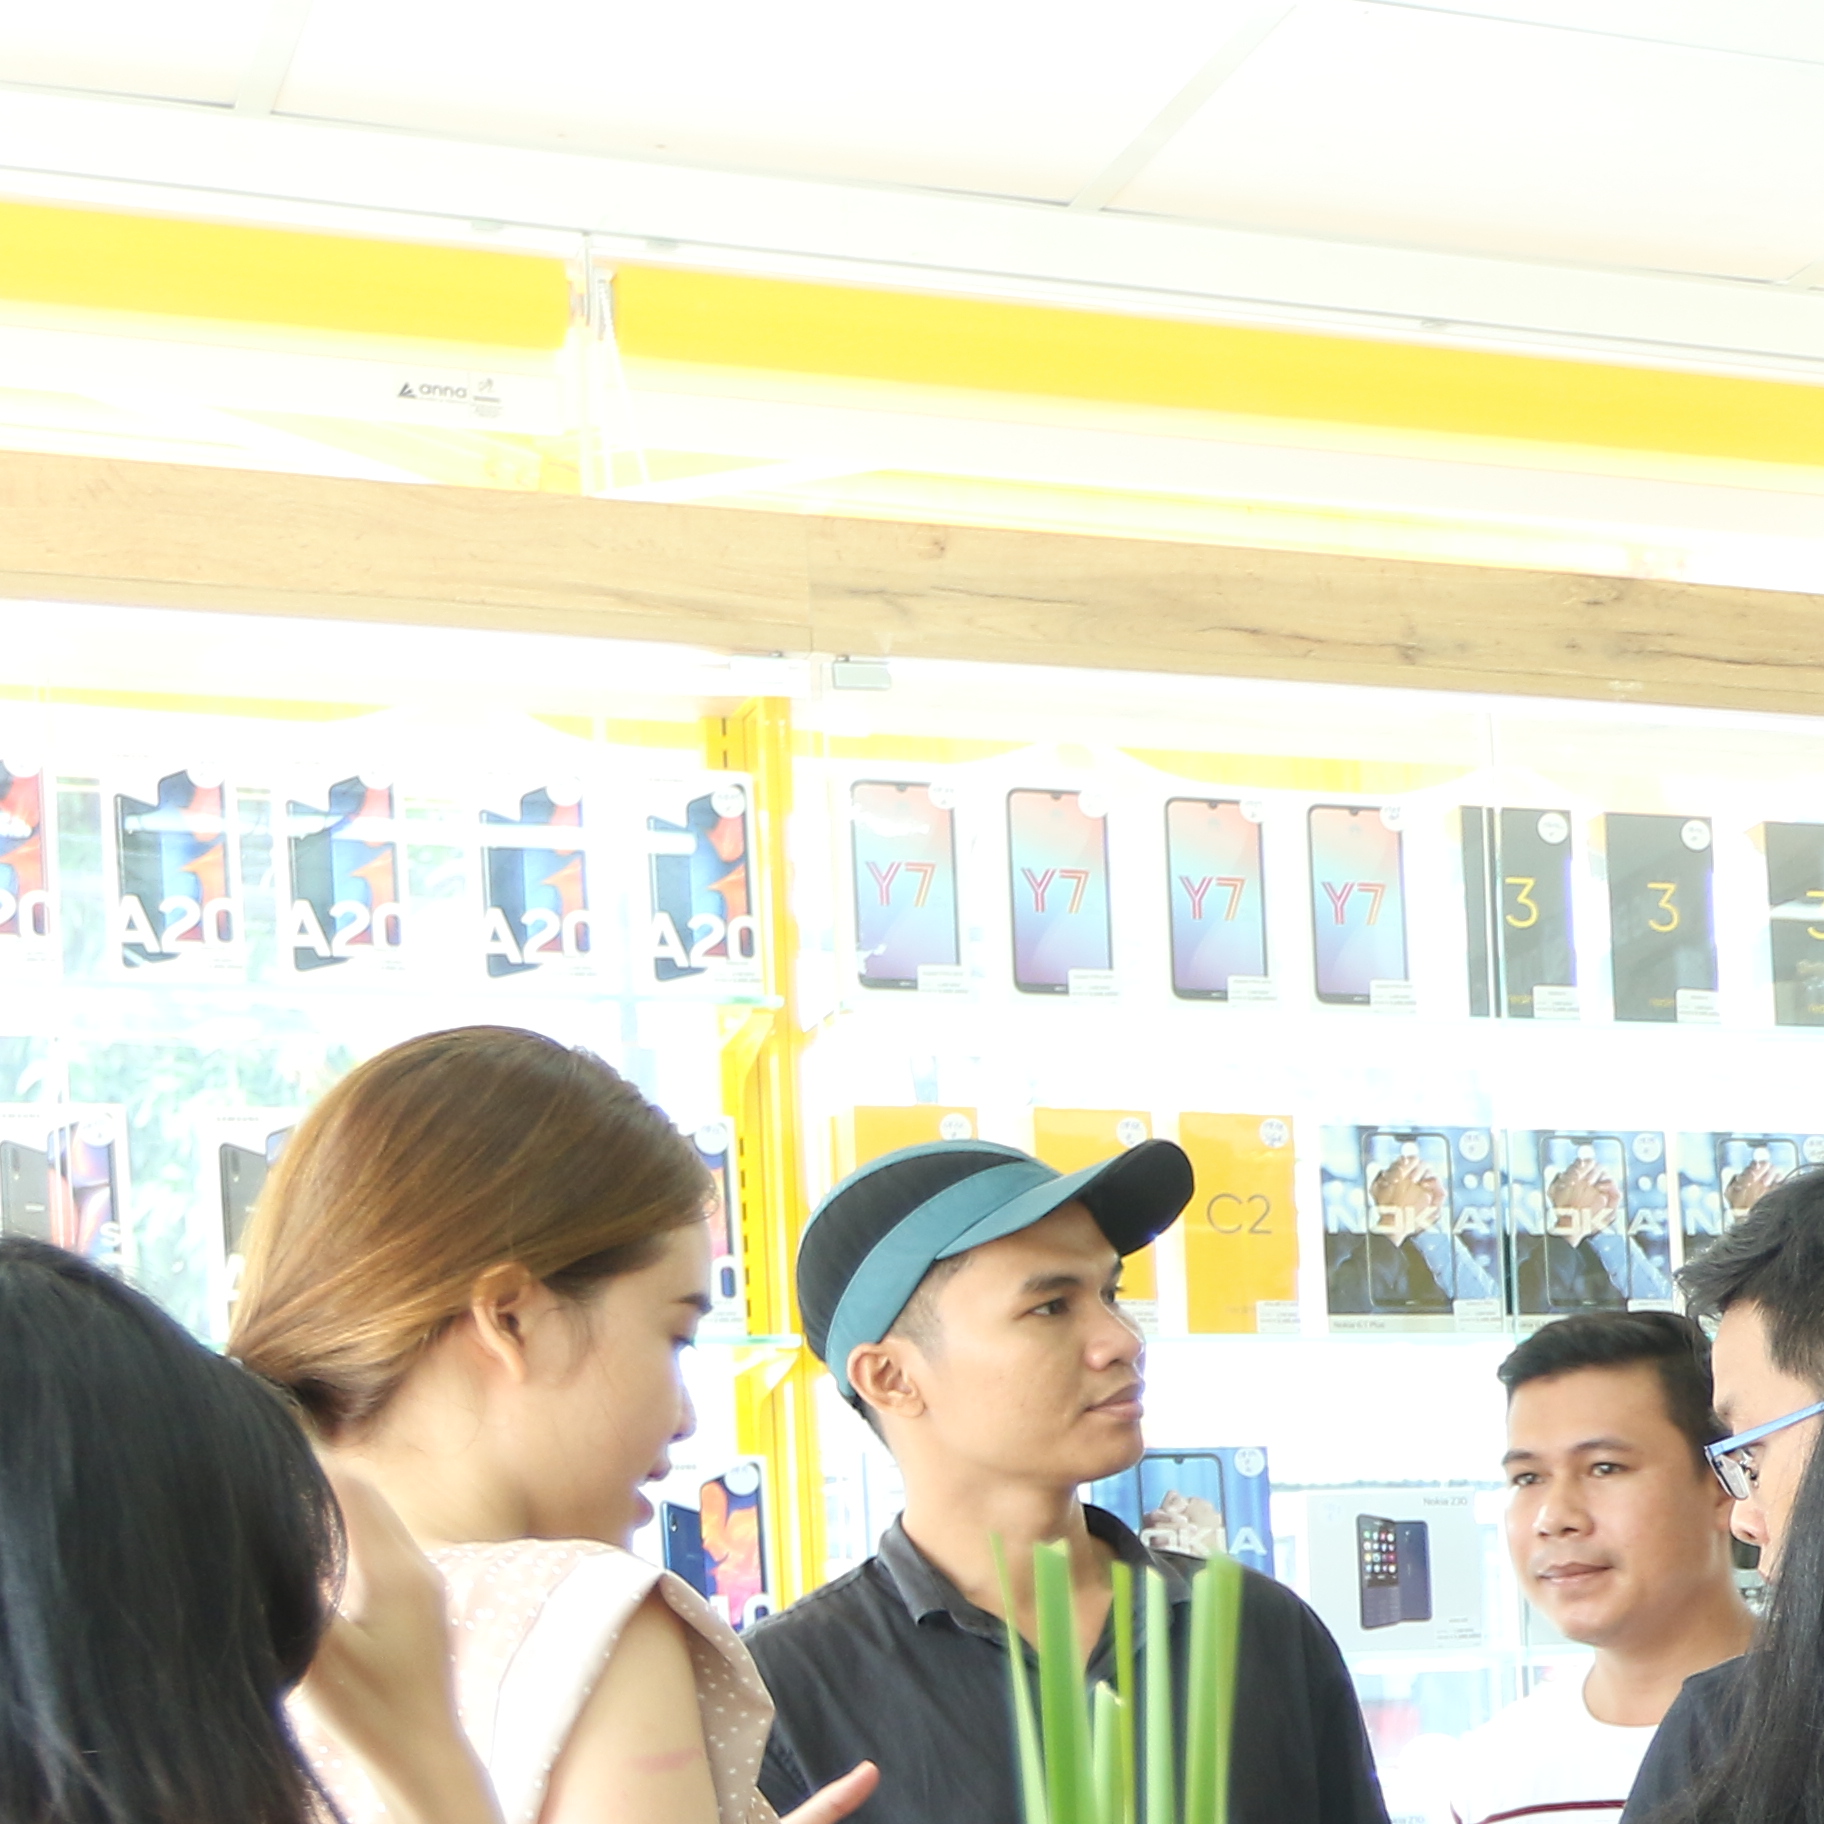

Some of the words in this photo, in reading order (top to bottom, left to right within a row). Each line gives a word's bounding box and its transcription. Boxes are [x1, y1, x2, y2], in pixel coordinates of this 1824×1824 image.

[865, 861, 936, 907] Y7
[1022, 868, 1089, 913] Y7
[1179, 876, 1246, 921] Y7
[1322, 881, 1386, 925] Y7
[1505, 877, 1539, 928] 3
[114, 895, 246, 955] A20
[285, 899, 412, 957] A20
[1647, 882, 1680, 932] 3
[477, 907, 601, 966] A20
[645, 911, 764, 970] A20
[1206, 1193, 1273, 1235] C2
[1326, 1206, 1490, 1236] NOKIA
[1507, 1206, 1665, 1237] NOKIA
[1423, 1497, 1449, 1507] Nokia
[1140, 1527, 1267, 1556] OKIA
